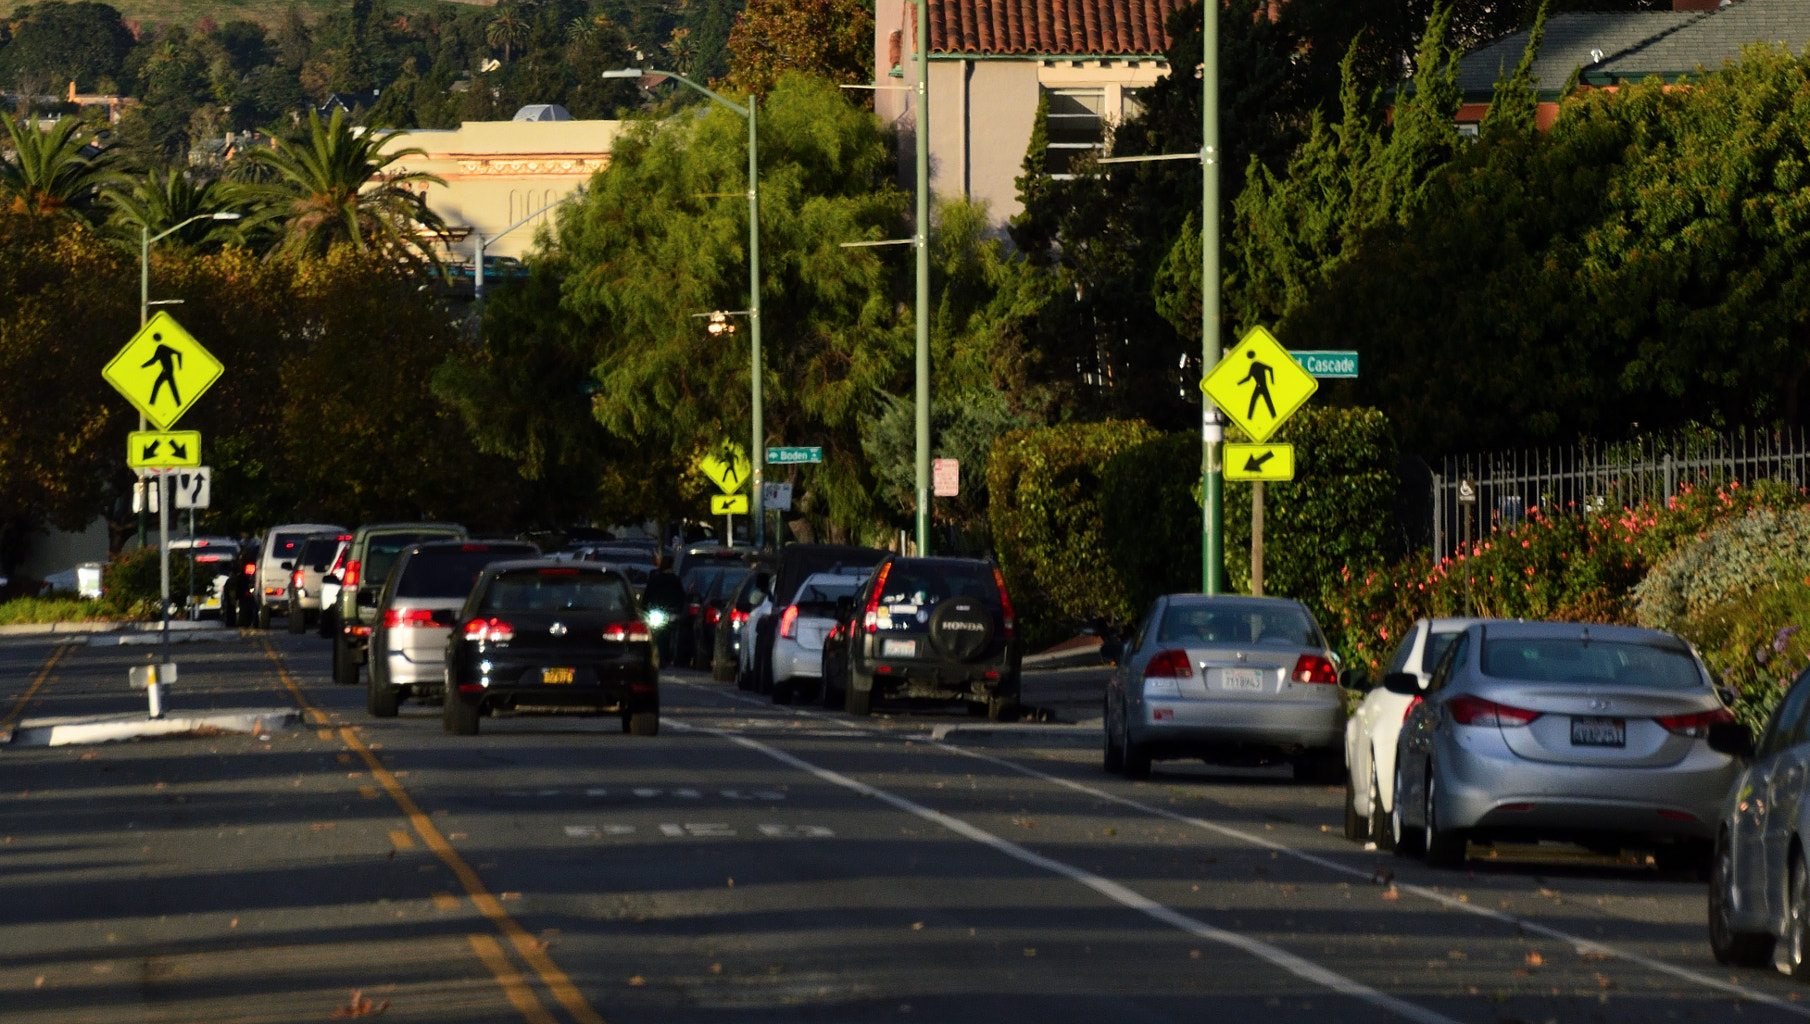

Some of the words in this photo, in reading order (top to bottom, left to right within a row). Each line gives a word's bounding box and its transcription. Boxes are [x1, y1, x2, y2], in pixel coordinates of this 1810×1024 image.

[1307, 356, 1354, 373] Cascade
[780, 450, 808, 461] Boden
[942, 621, 984, 631] HONDA
